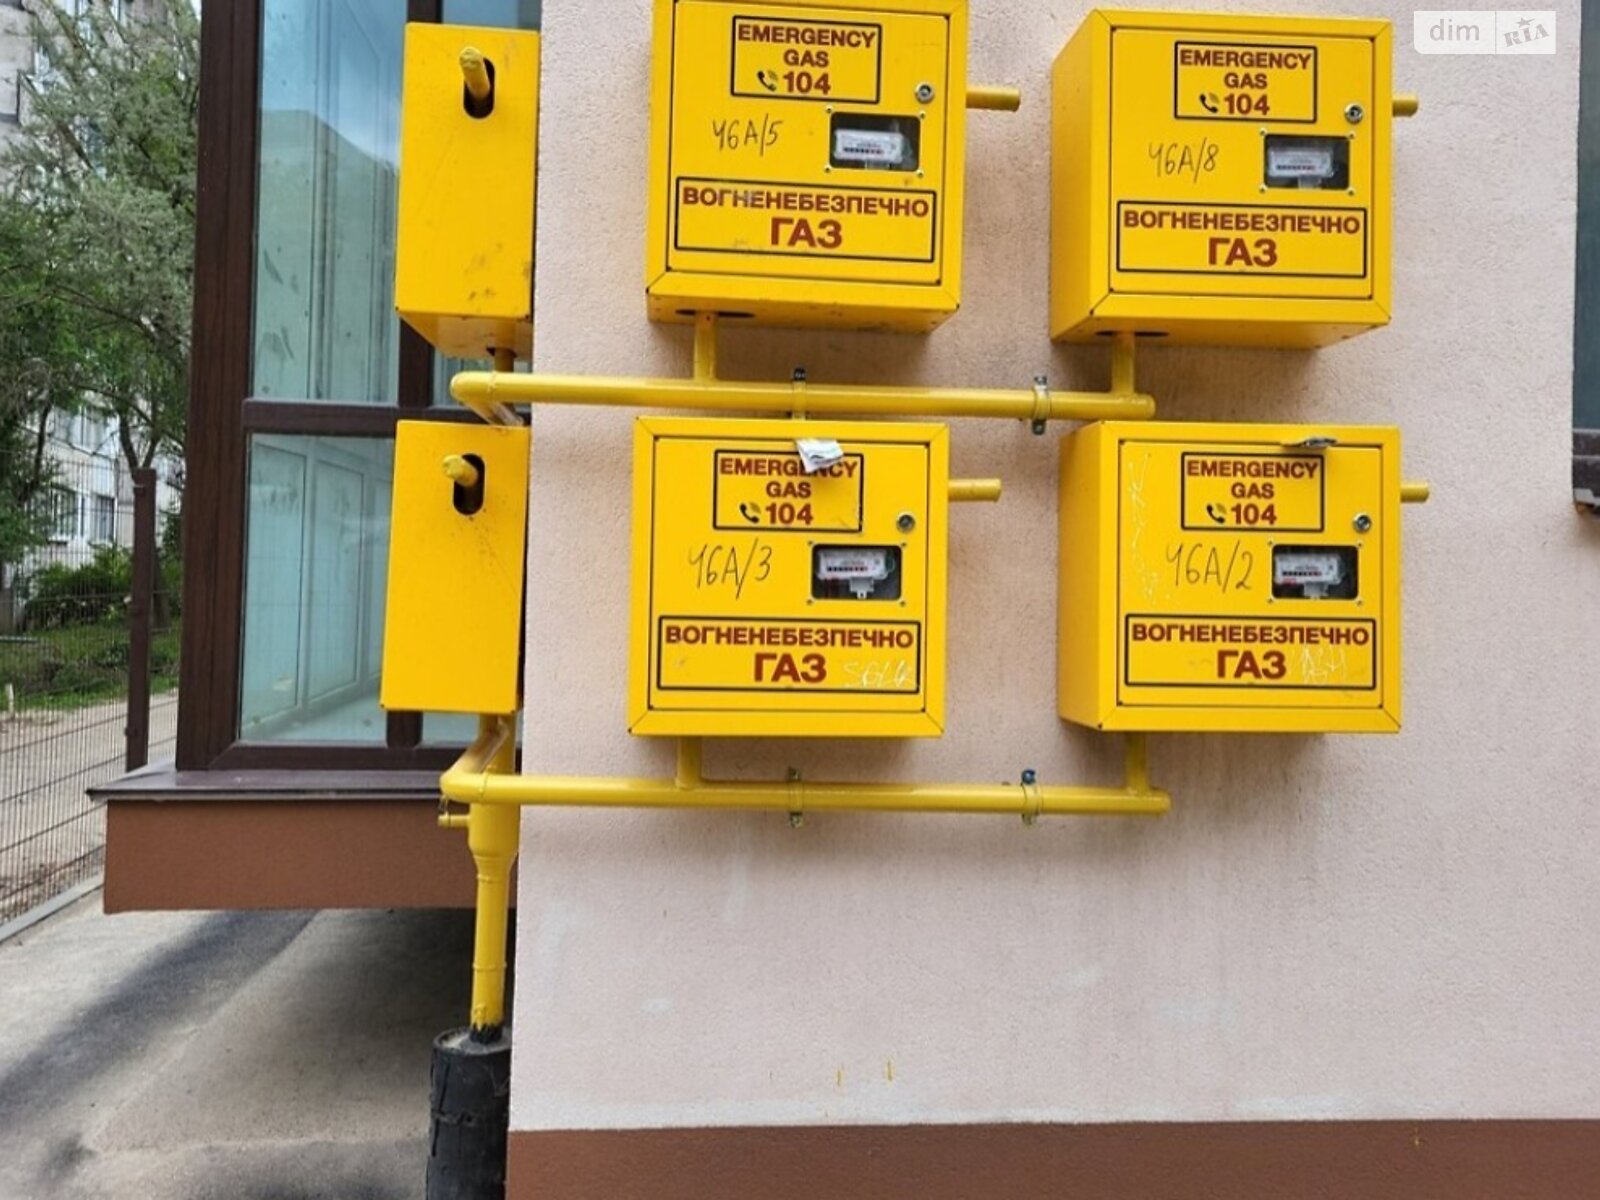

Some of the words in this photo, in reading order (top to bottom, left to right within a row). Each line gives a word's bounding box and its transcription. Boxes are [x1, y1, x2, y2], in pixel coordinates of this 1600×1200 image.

[737, 24, 876, 48] EMERGENCY
[783, 49, 829, 67] GAS
[1180, 49, 1311, 70] EMERGENCY
[783, 71, 831, 95] 104
[1224, 73, 1268, 90] GAS
[1224, 94, 1270, 116] 104
[683, 187, 929, 218] ВОГНЕНЕБЕЗПЕЧНО
[770, 217, 842, 249] ГАЗ
[1124, 210, 1361, 235] ВОГНЕНЕБЕЗПЕЧНО
[1208, 238, 1278, 268] ГАЗ
[1187, 460, 1318, 478] EMERGENCY
[766, 481, 811, 498] GAS
[1231, 483, 1274, 498] GAS
[766, 503, 814, 525] 104
[1231, 503, 1277, 525] 104
[665, 626, 914, 649] ВОГНЕНЕБЕЗПЕЧНО
[1132, 623, 1369, 645] ВОГНЕНЕБЕЗПЕЧНО
[754, 653, 827, 684] ГАЗ
[1216, 650, 1287, 679] ГАЗ
